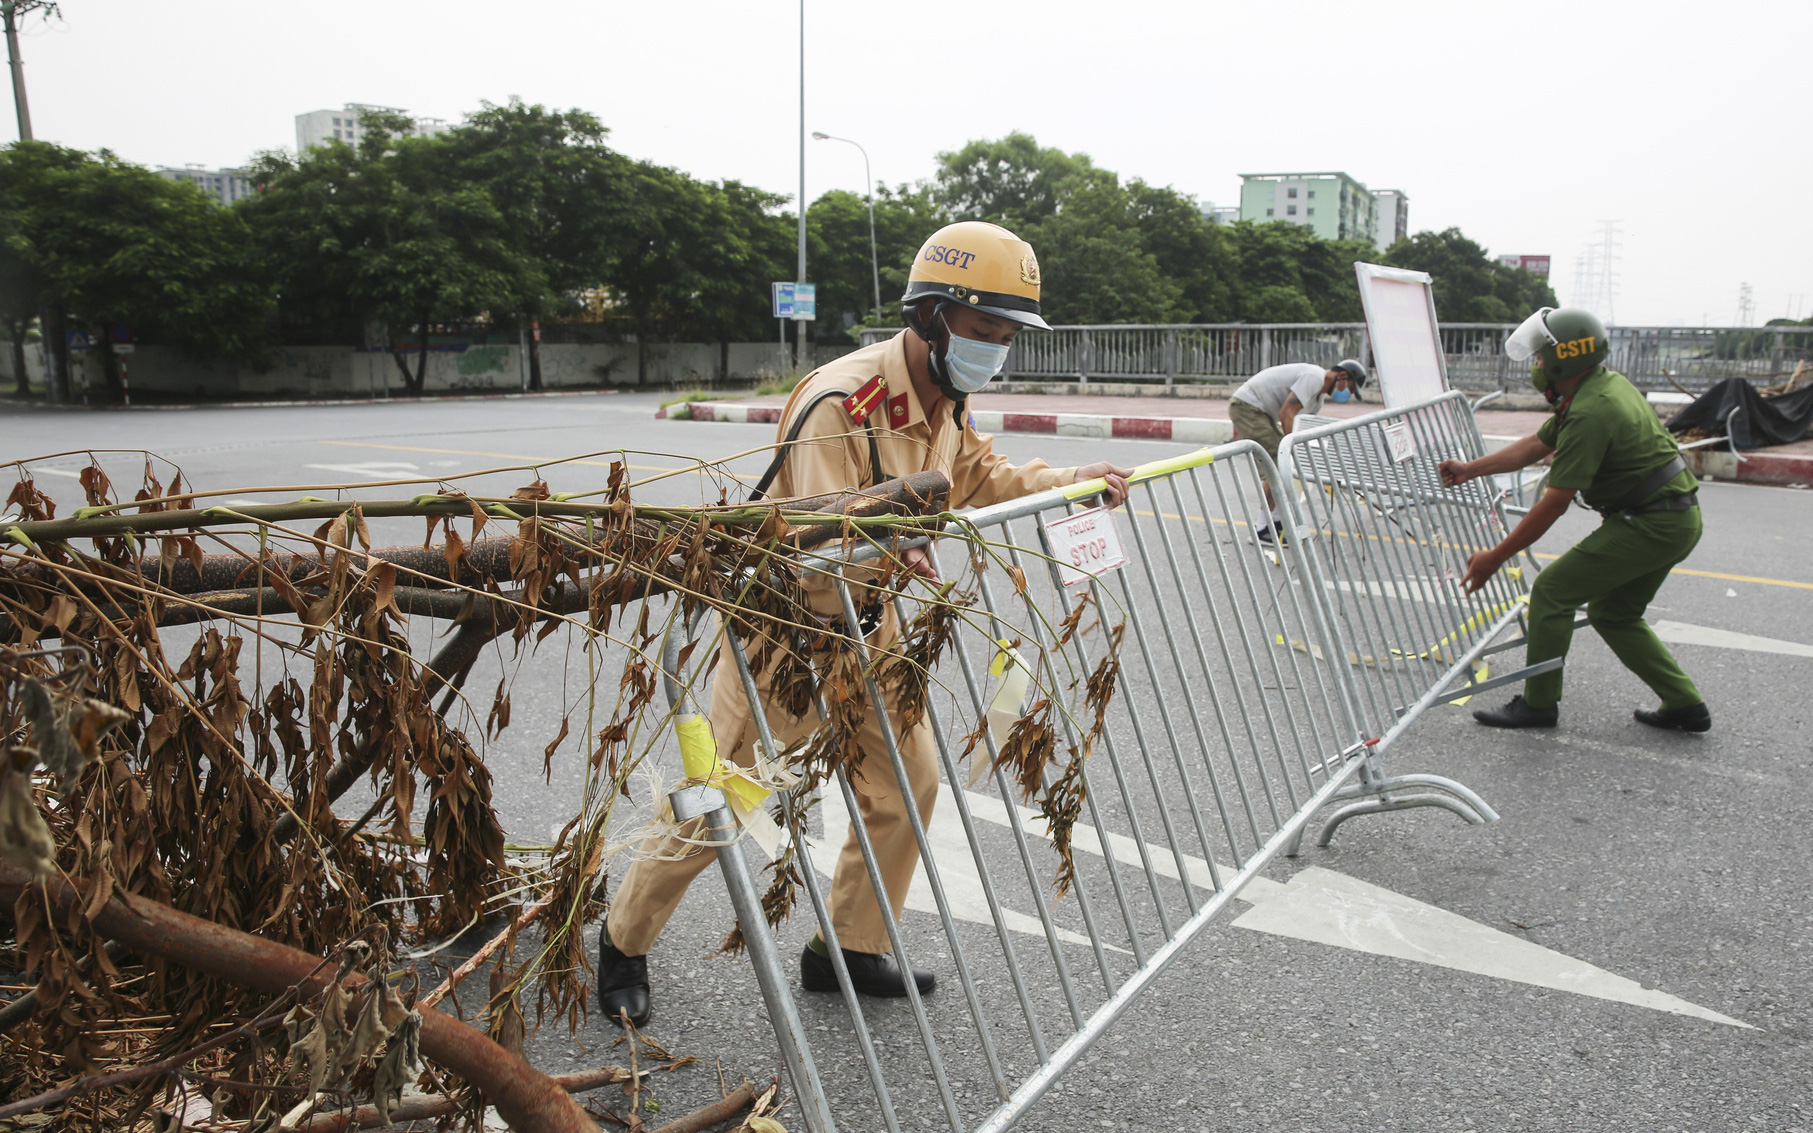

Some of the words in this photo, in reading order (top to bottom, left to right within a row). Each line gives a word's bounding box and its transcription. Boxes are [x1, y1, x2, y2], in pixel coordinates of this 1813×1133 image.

[924, 244, 976, 270] CSGT
[1556, 336, 1595, 359] CSTT
[1067, 519, 1095, 537] POLICE
[1070, 537, 1107, 567] STOP
